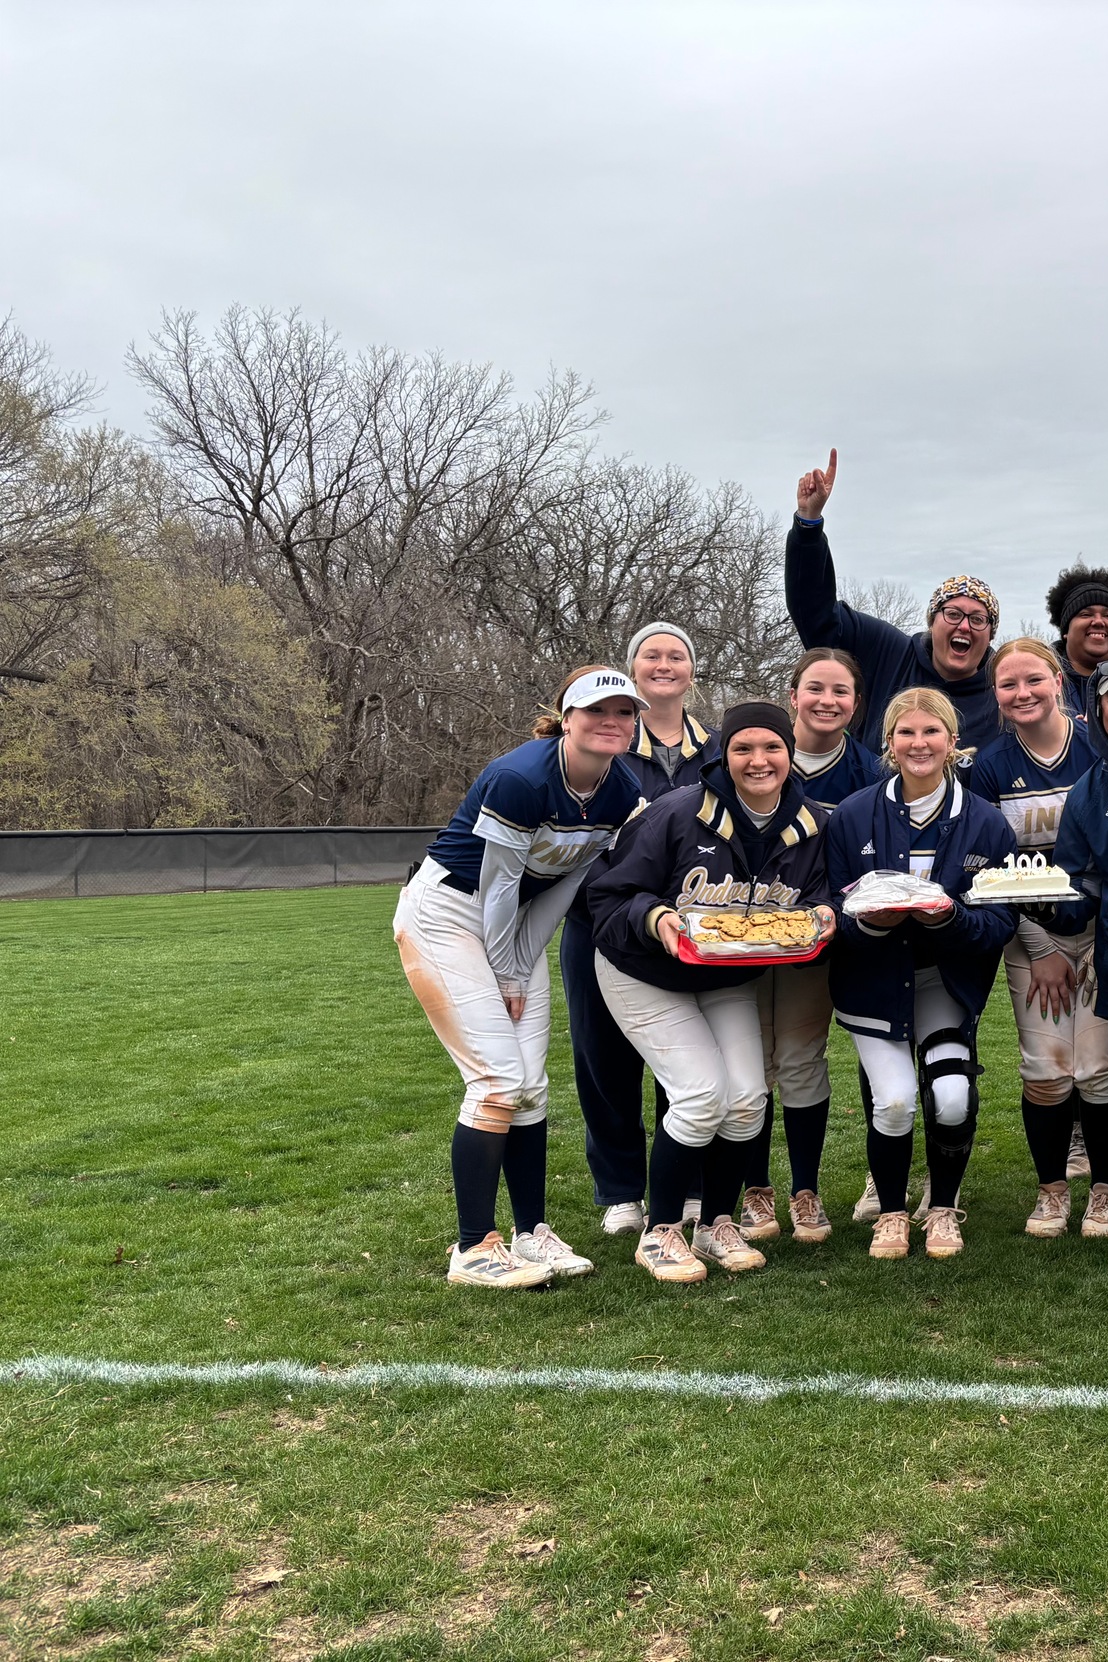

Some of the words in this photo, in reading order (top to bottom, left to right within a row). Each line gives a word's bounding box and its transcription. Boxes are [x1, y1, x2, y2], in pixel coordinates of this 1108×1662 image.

[595, 676, 626, 687] INDY
[1023, 804, 1064, 834] IN
[1003, 851, 1047, 869] 100
